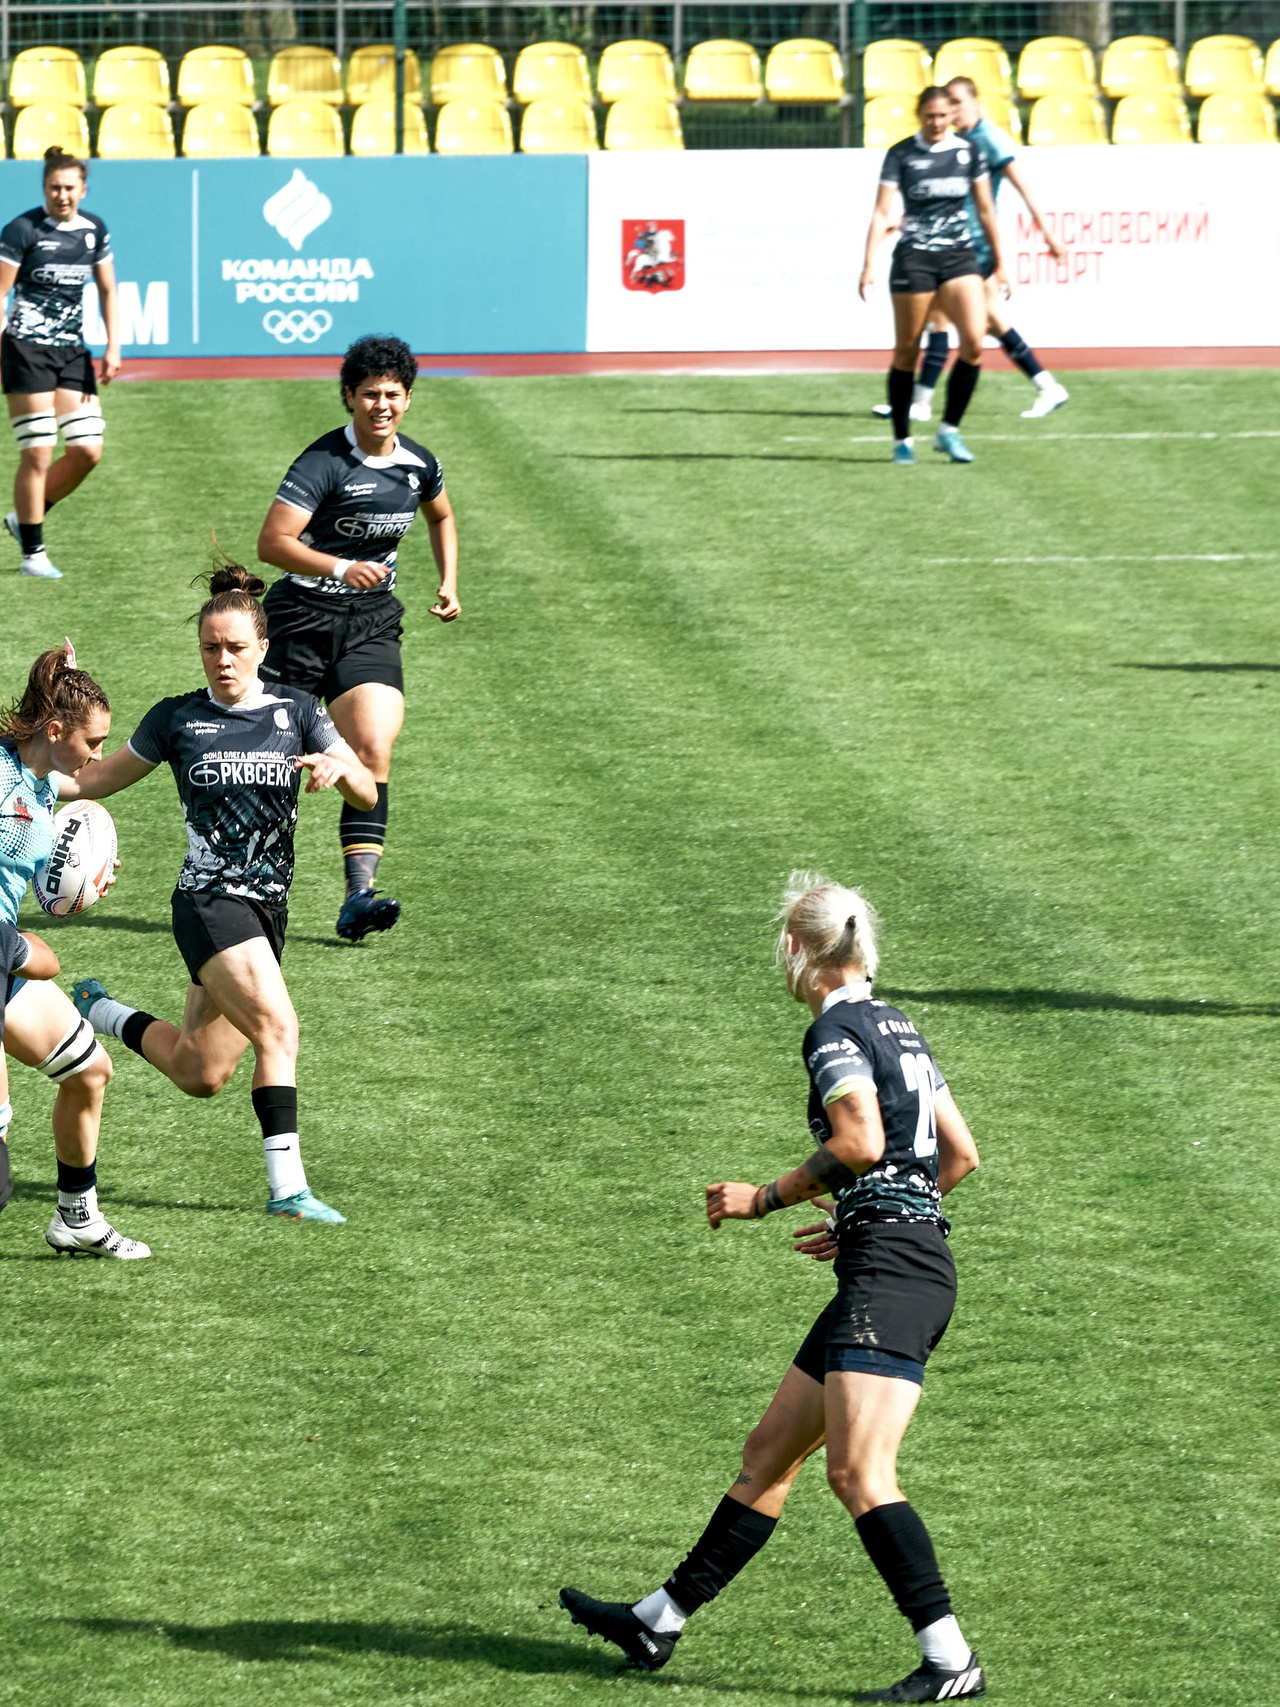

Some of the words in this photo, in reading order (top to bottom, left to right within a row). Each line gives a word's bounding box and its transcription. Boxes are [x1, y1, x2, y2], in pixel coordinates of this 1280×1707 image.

[221, 258, 375, 281] КОМАНДА
[235, 281, 359, 304] РОССИИ
[45, 818, 82, 895] RHINO
